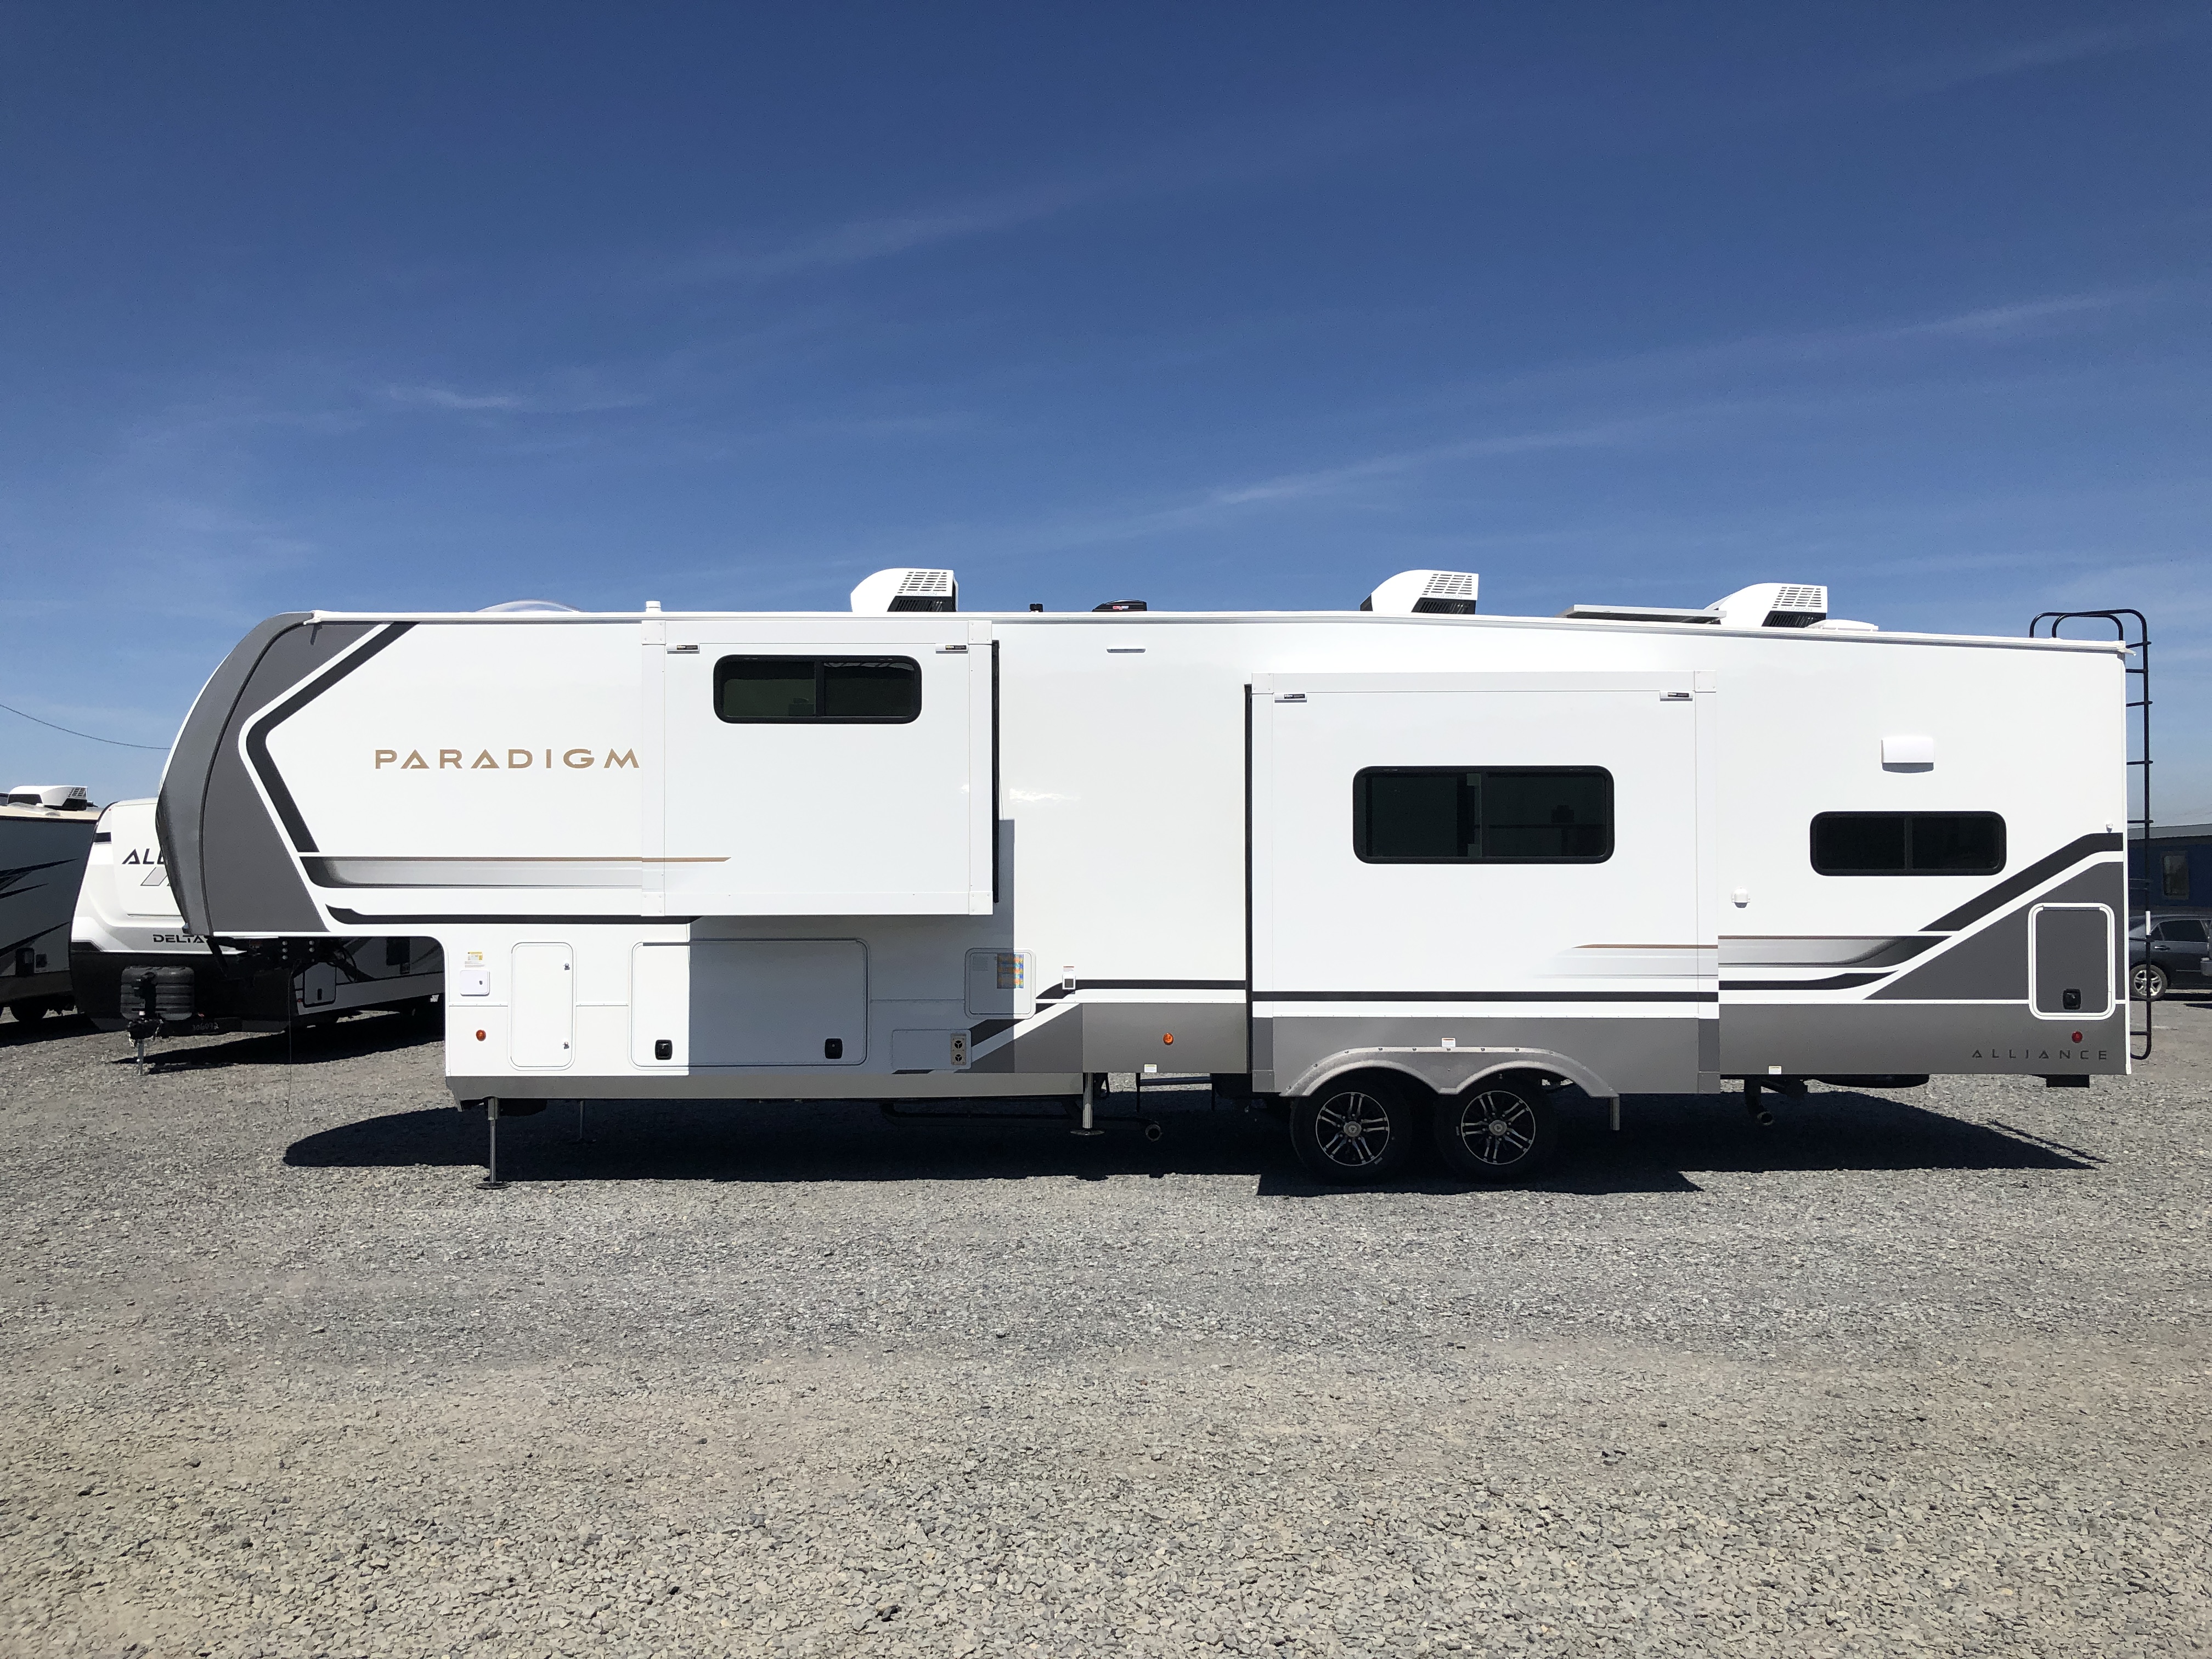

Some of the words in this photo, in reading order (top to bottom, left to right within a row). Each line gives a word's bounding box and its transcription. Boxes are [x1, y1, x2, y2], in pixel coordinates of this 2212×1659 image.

[375, 748, 640, 769] PARADIGM
[153, 934, 205, 943] DELTA
[1972, 1049, 2107, 1060] ALLIANCE
